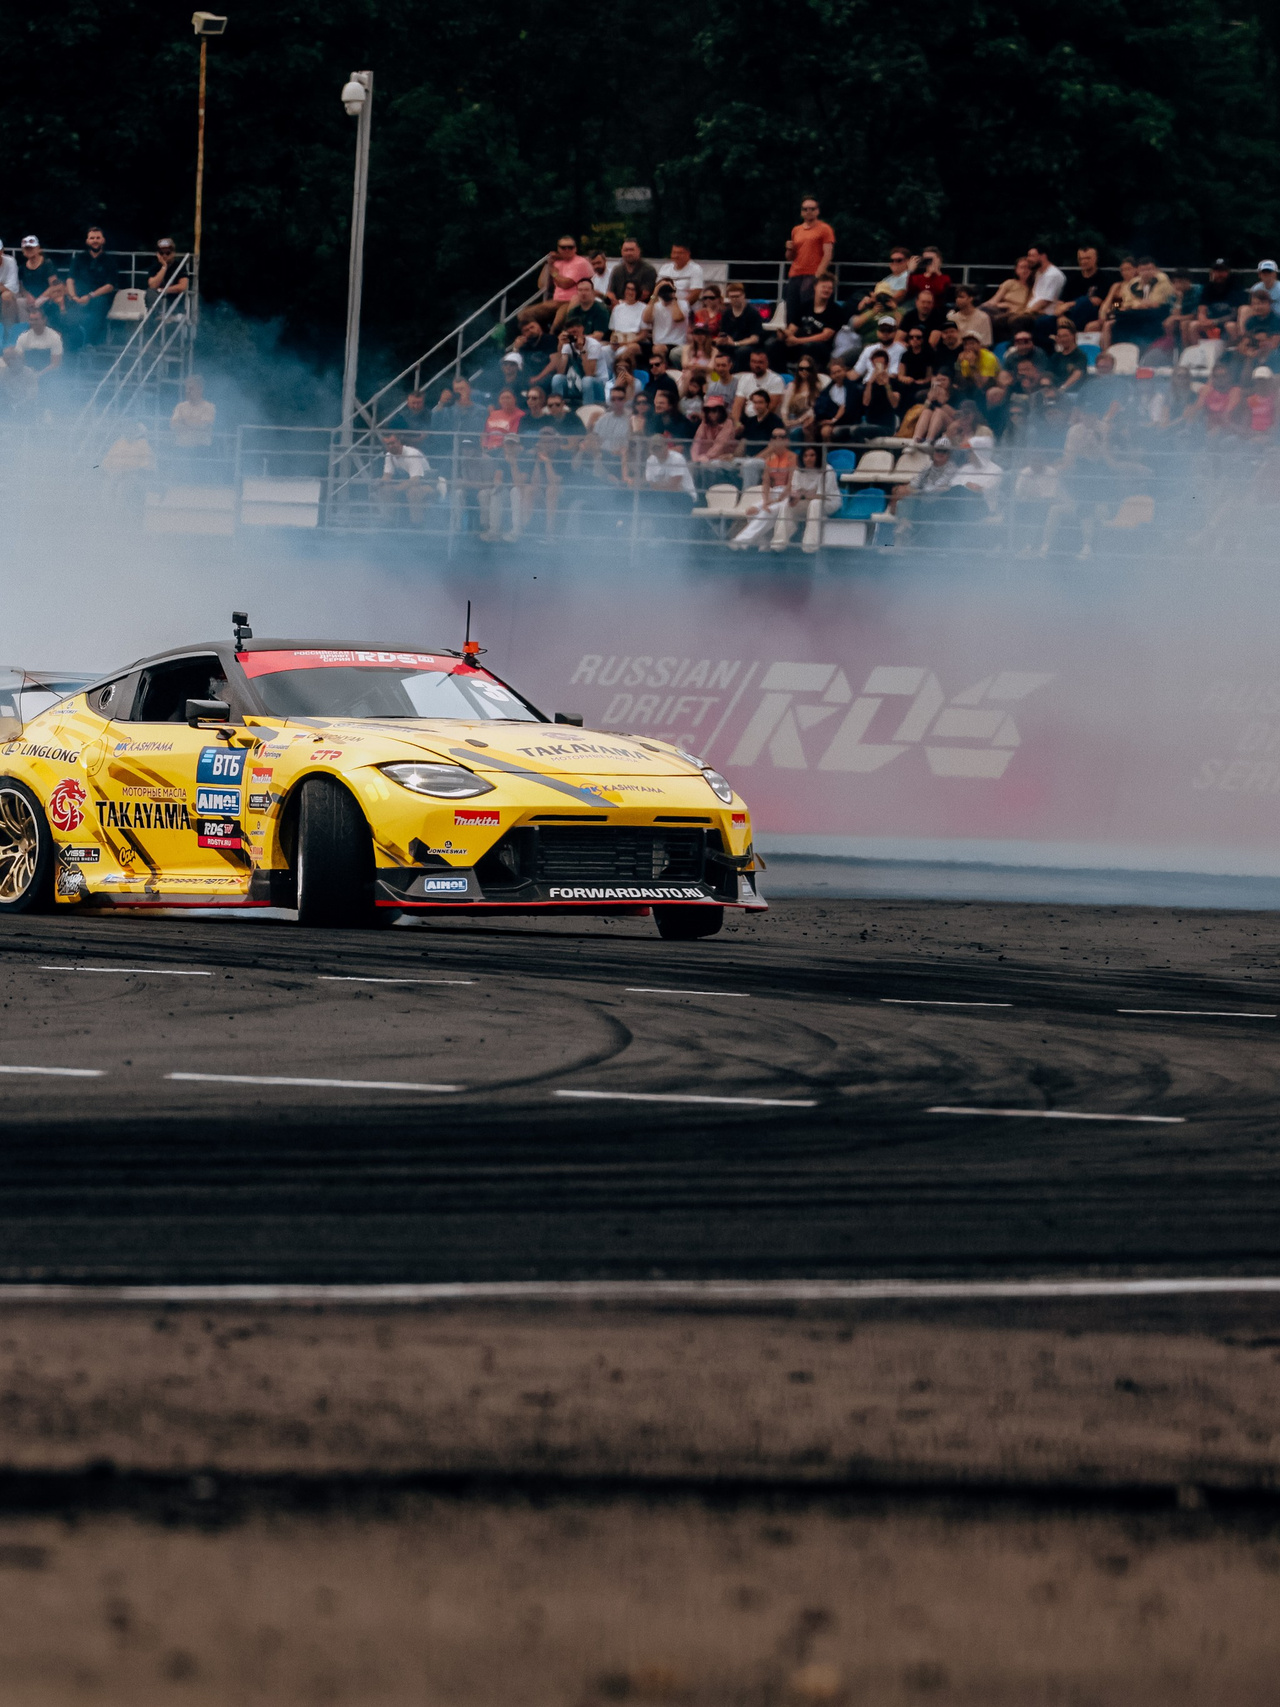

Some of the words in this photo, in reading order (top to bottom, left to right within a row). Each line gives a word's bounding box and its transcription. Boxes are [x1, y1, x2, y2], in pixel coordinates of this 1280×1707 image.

[570, 655, 742, 689] RUSSIAN
[602, 693, 721, 727] DRIFT
[725, 661, 1060, 779] RDS
[21, 743, 80, 764] LINGLONG
[128, 742, 174, 752] KASHIYAMA
[516, 743, 653, 761] TAKAYAMA
[122, 787, 161, 797] МОТОРНЫЕ
[163, 788, 187, 797] МАСЛА
[601, 784, 665, 794] KASHIYAMA
[198, 793, 239, 811] AIMOL
[95, 801, 192, 830] TAKAYAMA
[426, 880, 466, 890] AIMOL
[549, 887, 705, 898] FORWARDAUTO.RU
